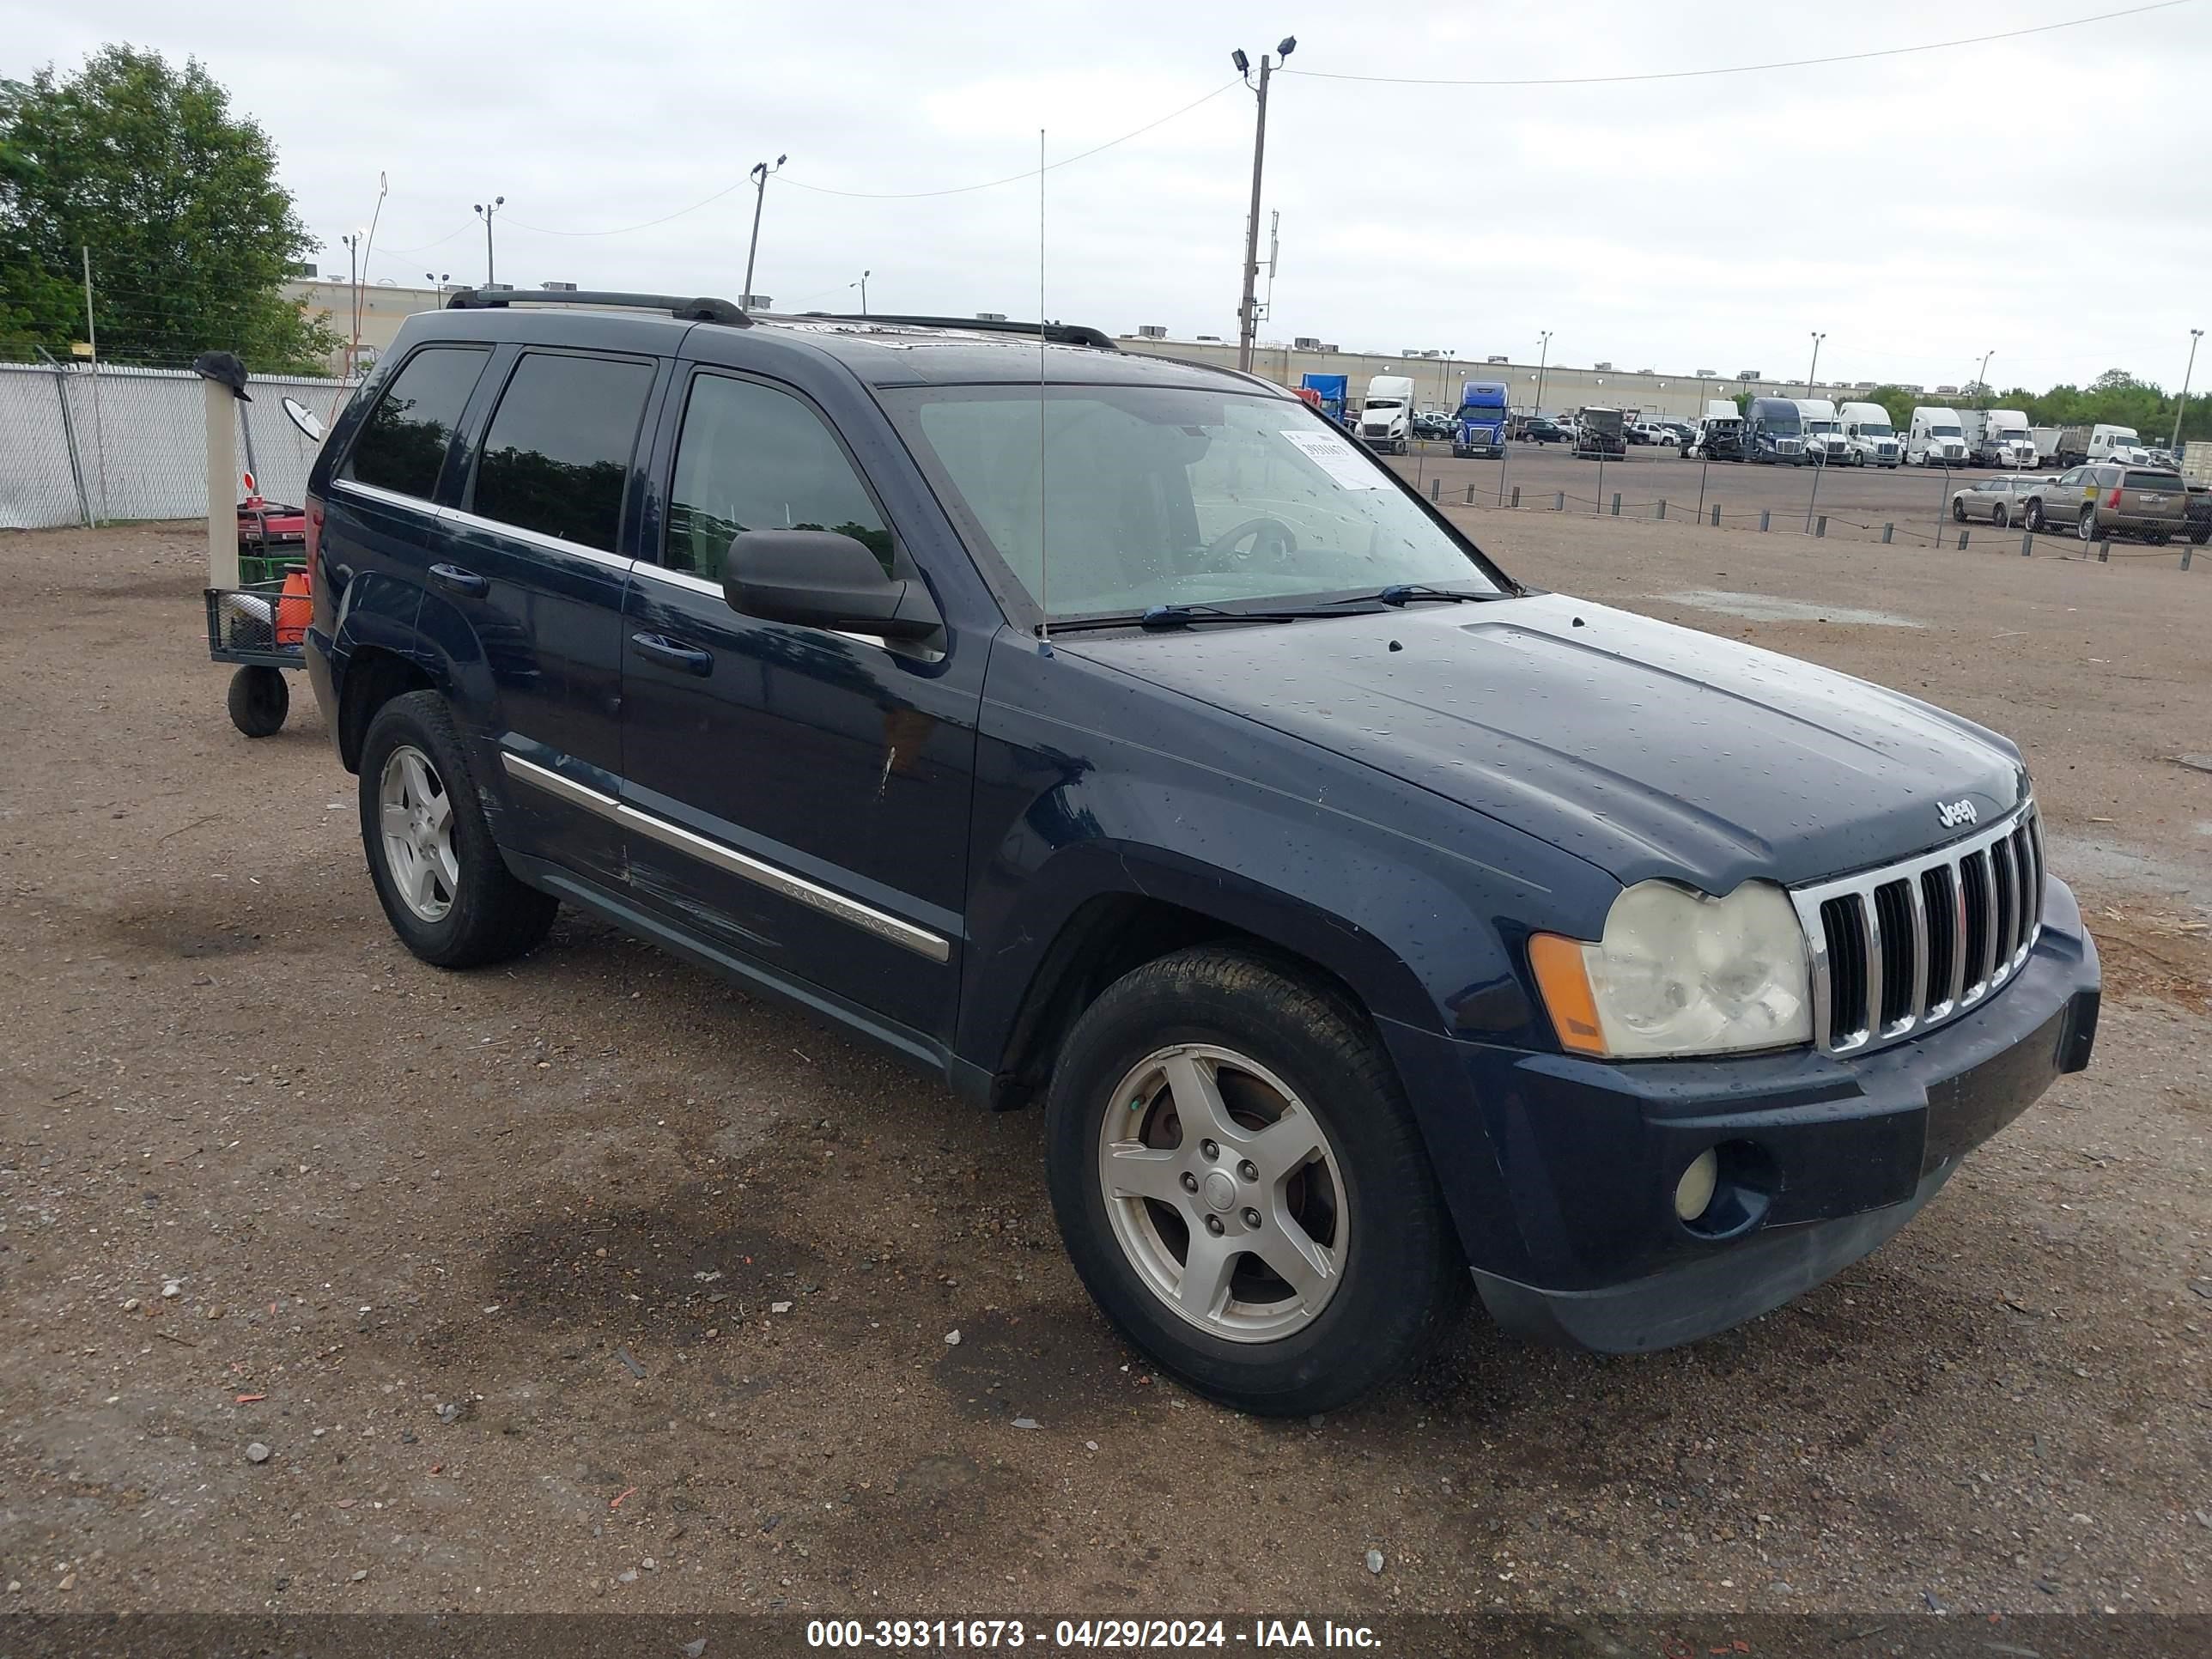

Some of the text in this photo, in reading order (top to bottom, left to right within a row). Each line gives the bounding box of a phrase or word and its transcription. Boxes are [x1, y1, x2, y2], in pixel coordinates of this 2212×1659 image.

[1936, 799, 1977, 827] Jeep
[782, 882, 909, 943] GRAND CHEROKEE
